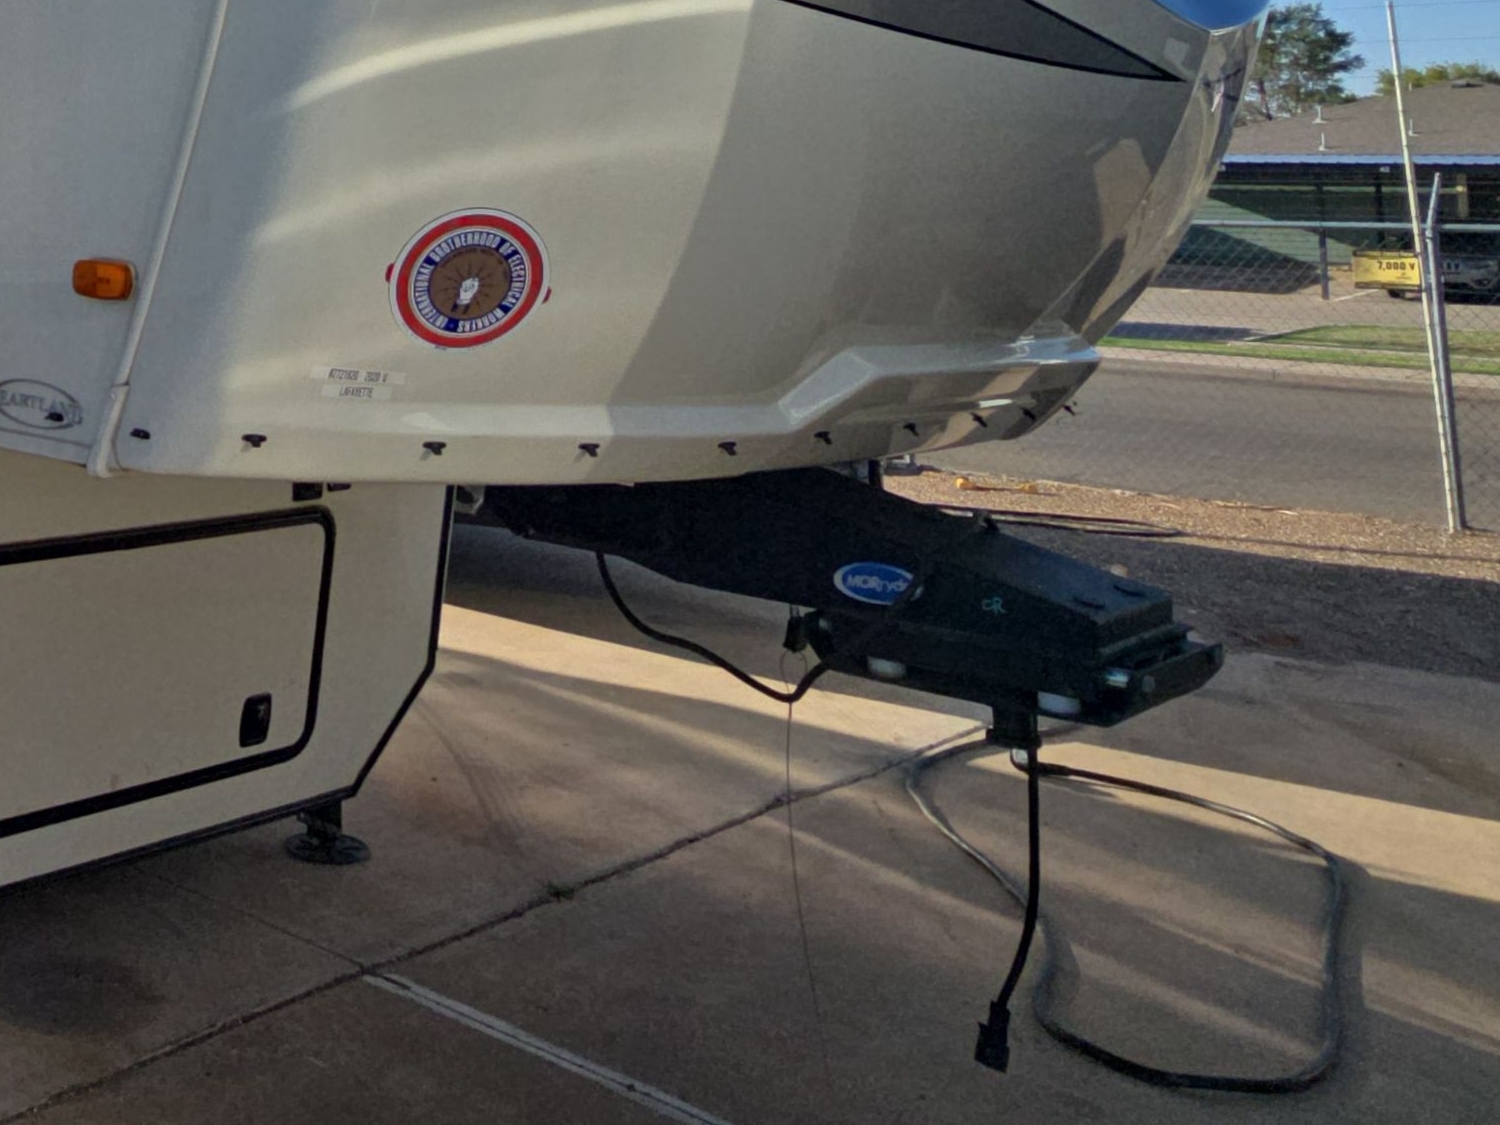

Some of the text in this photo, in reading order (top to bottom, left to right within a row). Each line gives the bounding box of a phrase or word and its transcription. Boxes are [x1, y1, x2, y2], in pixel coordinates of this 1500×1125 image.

[431, 230, 501, 262] BROTHERHOOD
[498, 241, 514, 256] OF
[1377, 260, 1416, 271] 7,000 V
[507, 254, 526, 307] ELECTRICAL
[414, 263, 449, 329] INTERNATIONAL
[456, 307, 505, 333] WORKERS
